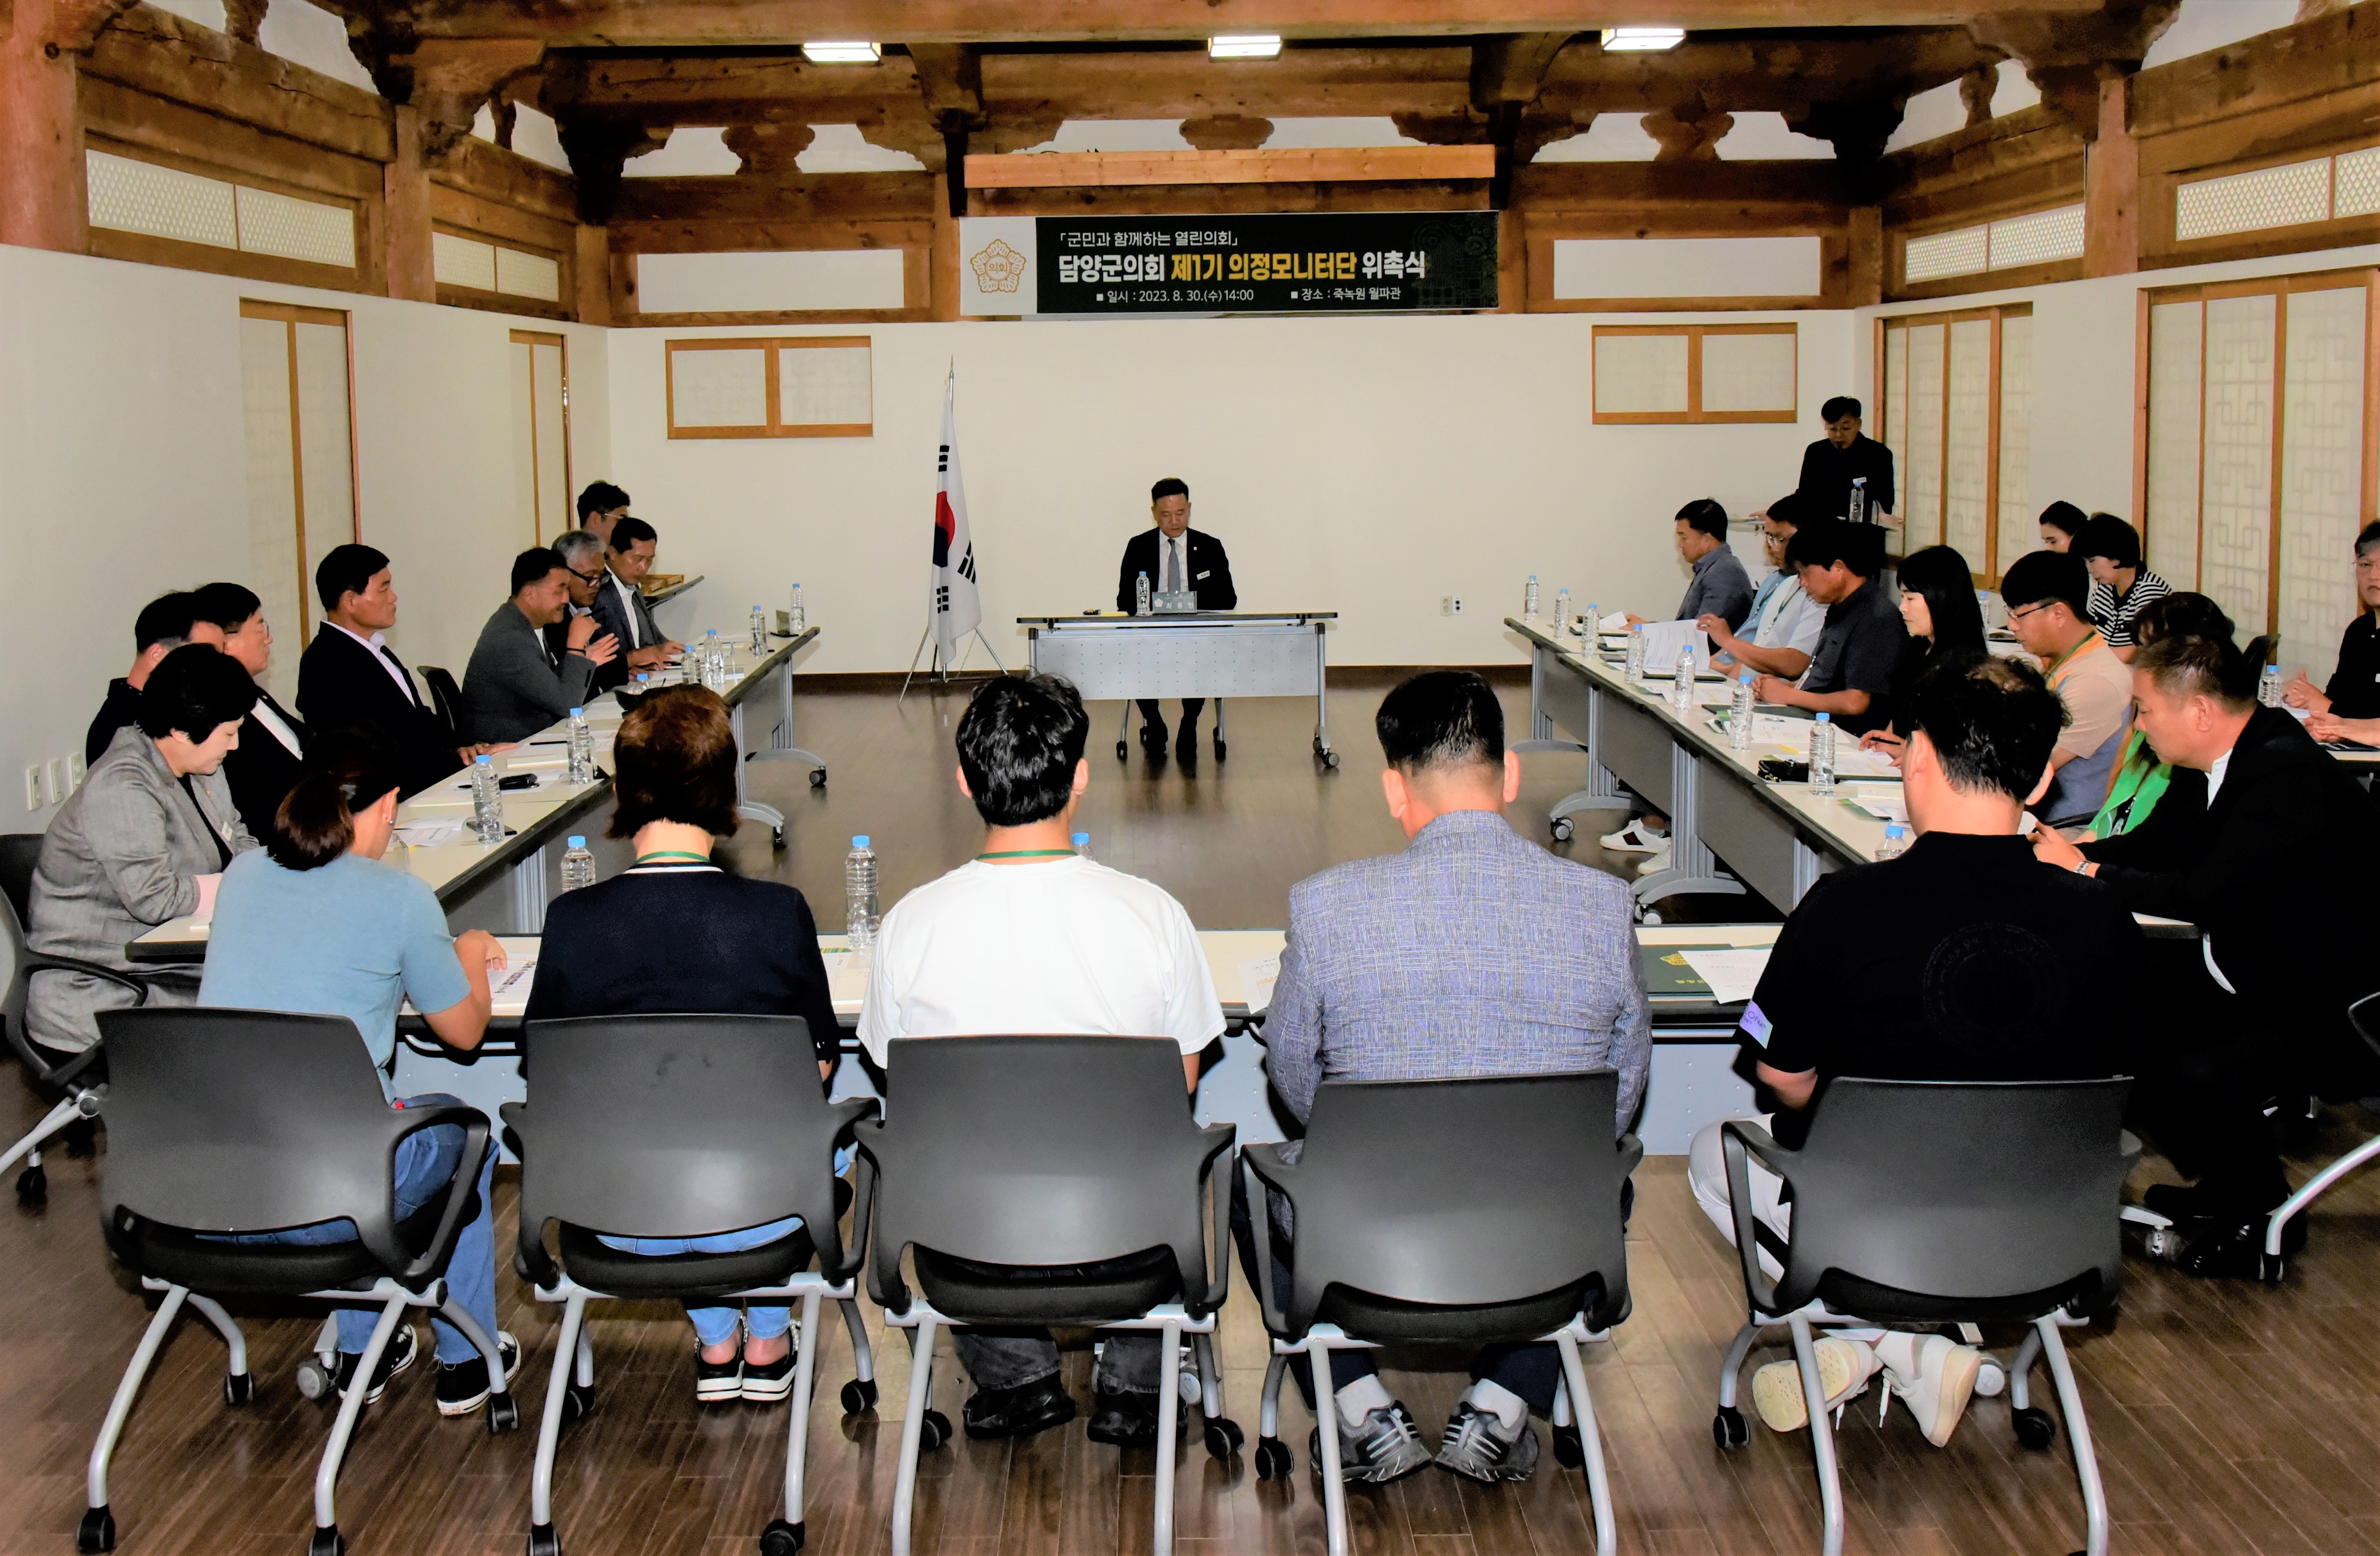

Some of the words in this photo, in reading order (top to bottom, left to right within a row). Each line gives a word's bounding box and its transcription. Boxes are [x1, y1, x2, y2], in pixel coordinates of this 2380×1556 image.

[1114, 231, 1171, 246] 함께하는
[989, 261, 1008, 274] 의회
[1059, 254, 1165, 283] 담양군의회
[1171, 253, 1222, 281] 제1기
[1228, 252, 1358, 281] 의정모니터단
[1362, 250, 1426, 279] 위촉식
[1107, 290, 1128, 303] 일시
[1139, 290, 1170, 302] 2023.
[1173, 290, 1183, 301] 8.
[1224, 289, 1254, 301] 14:00
[1301, 288, 1324, 301] 장소
[1333, 288, 1365, 300] 죽녹원
[1368, 287, 1401, 300] 월파관
